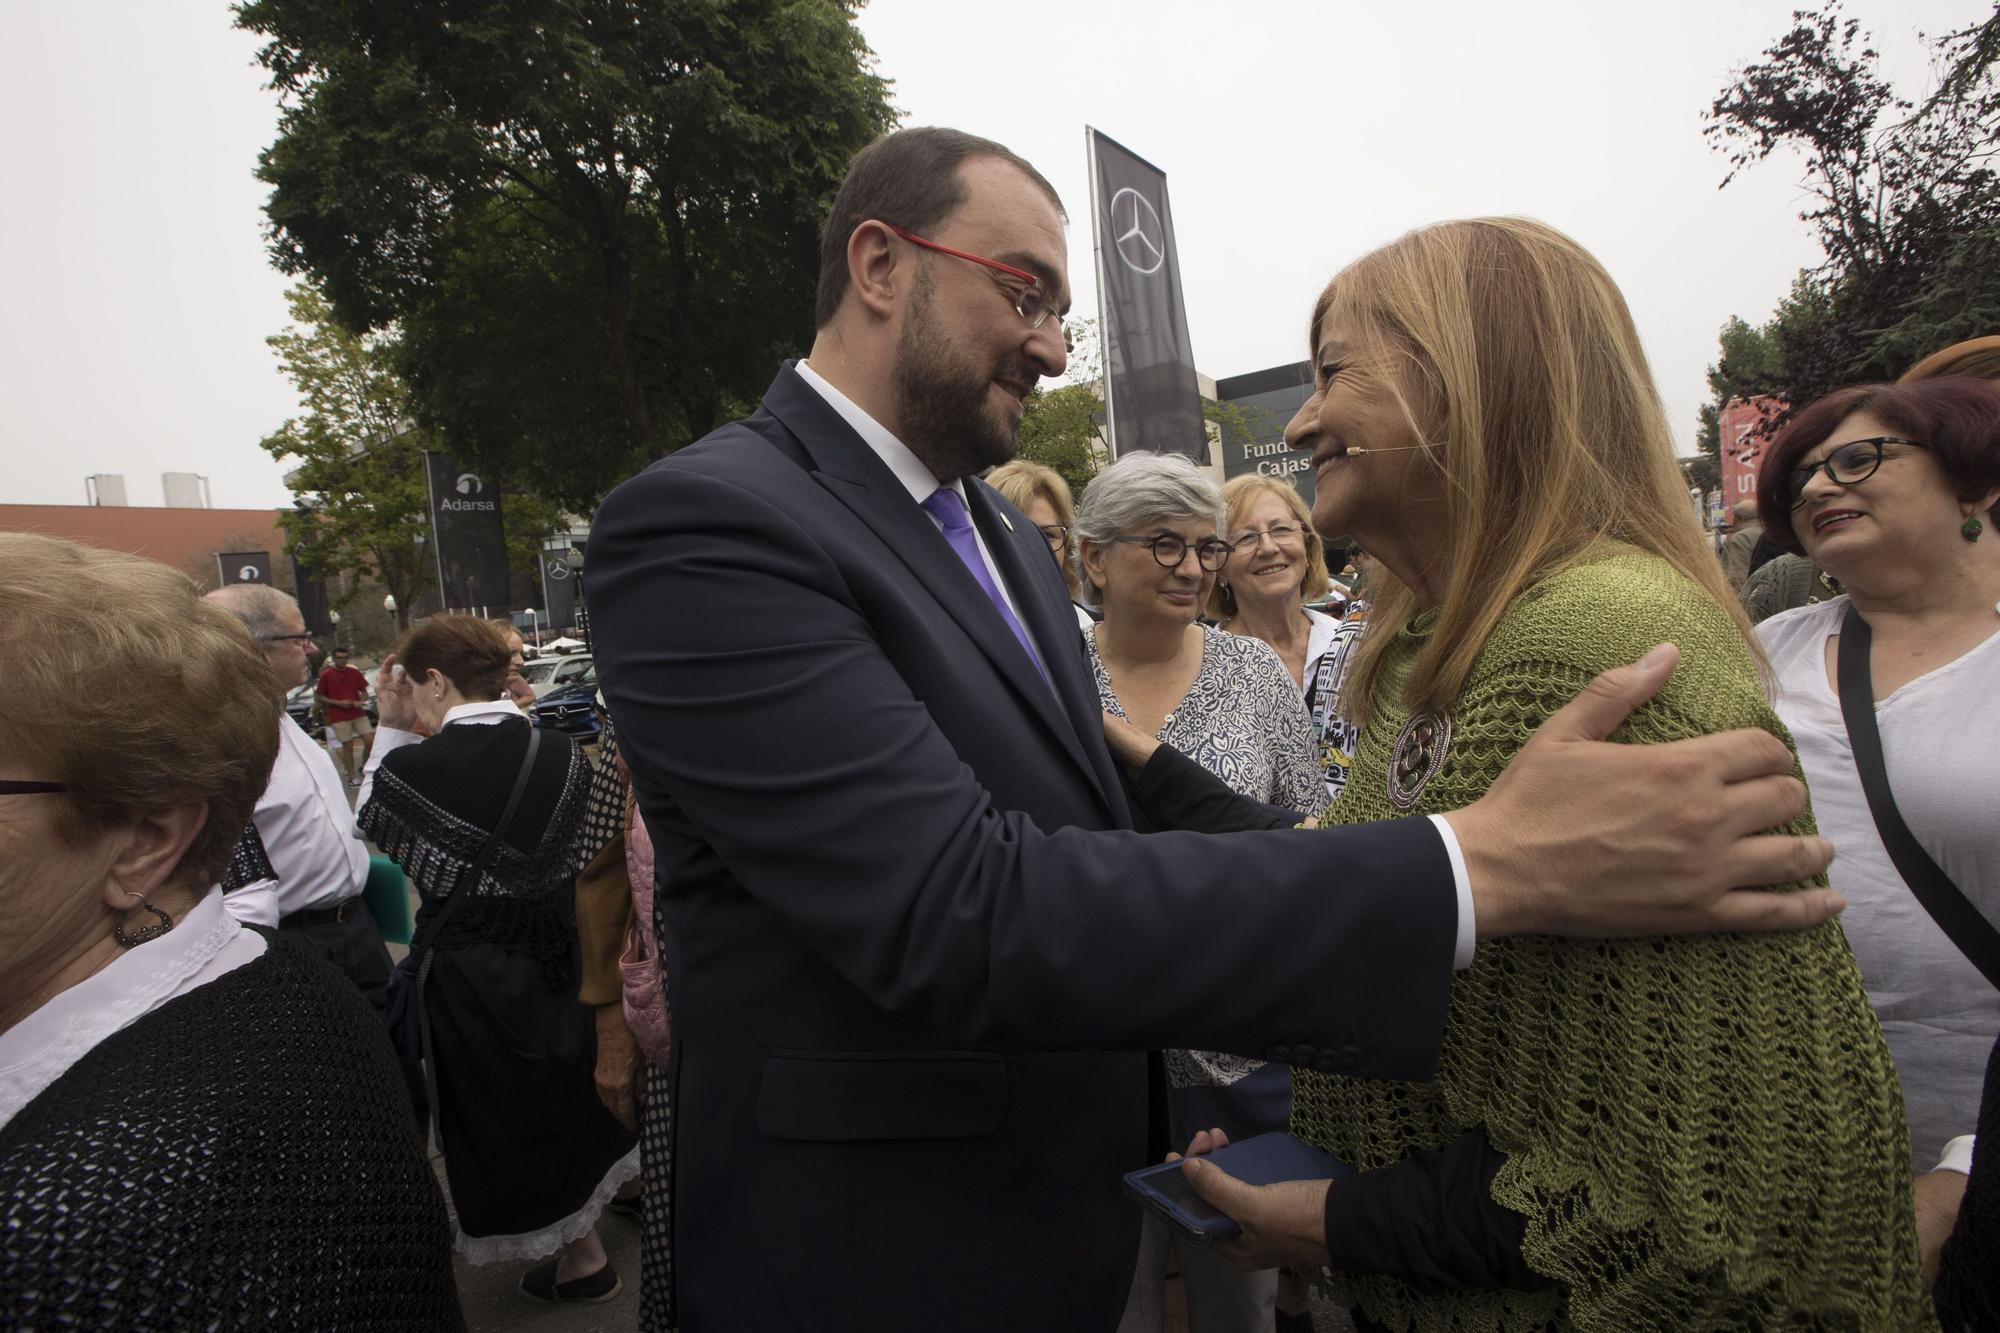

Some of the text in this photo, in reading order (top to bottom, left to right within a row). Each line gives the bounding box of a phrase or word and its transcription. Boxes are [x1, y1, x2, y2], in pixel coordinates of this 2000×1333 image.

[1243, 437, 1295, 459] Fund
[1257, 456, 1313, 477] Cajas
[441, 497, 495, 511] Adarsa
